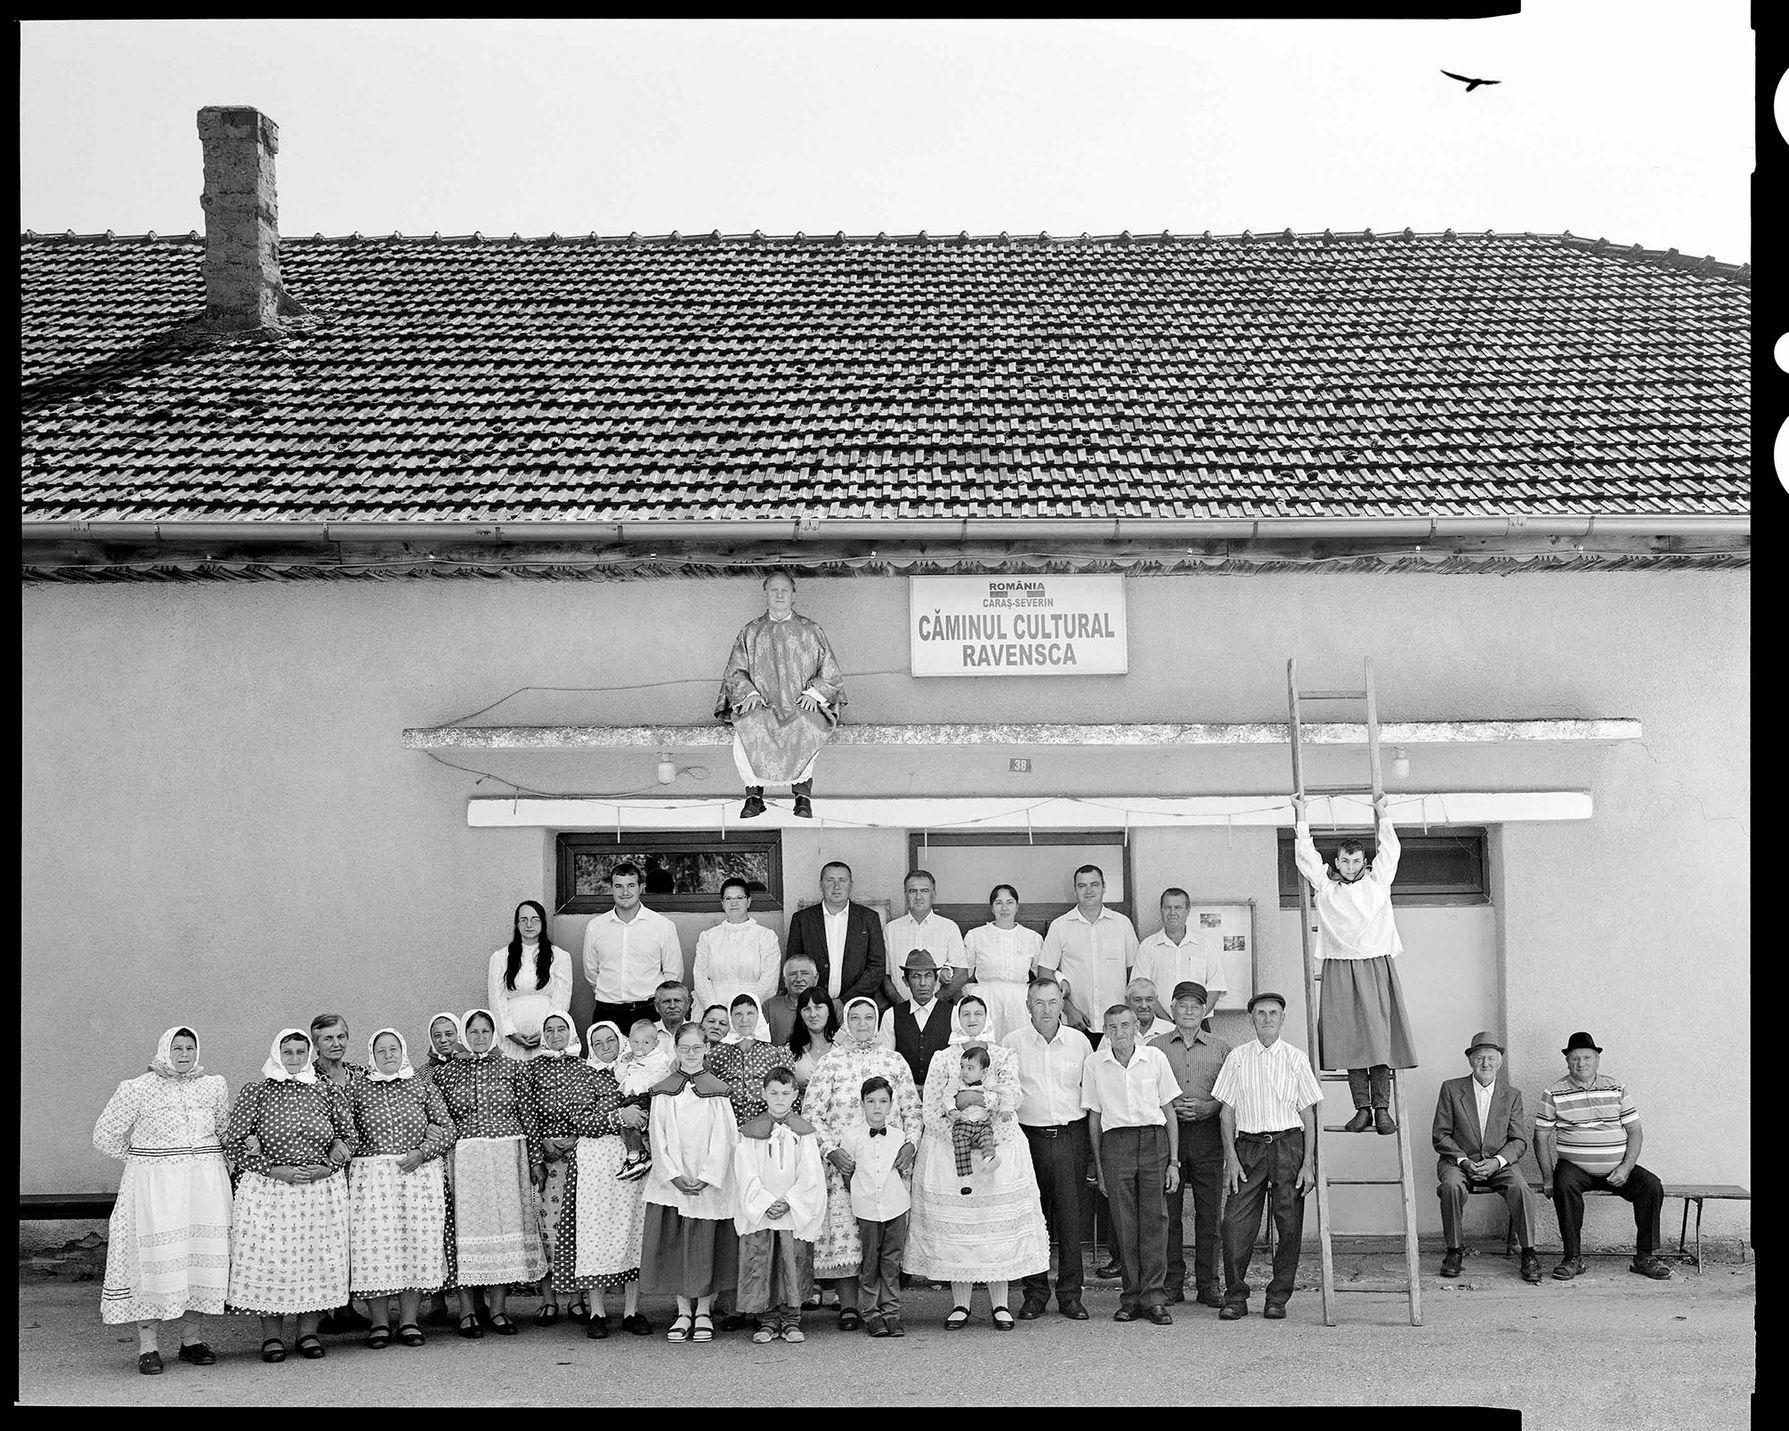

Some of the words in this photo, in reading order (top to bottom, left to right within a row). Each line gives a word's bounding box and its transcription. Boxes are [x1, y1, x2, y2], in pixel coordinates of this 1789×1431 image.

[989, 580, 1045, 590] ROMÂNIA
[918, 608, 1007, 641] CĂMINUL
[1013, 613, 1115, 640] CULTURAL
[962, 643, 1077, 667] RAVENSCA
[1014, 760, 1027, 771] 38
